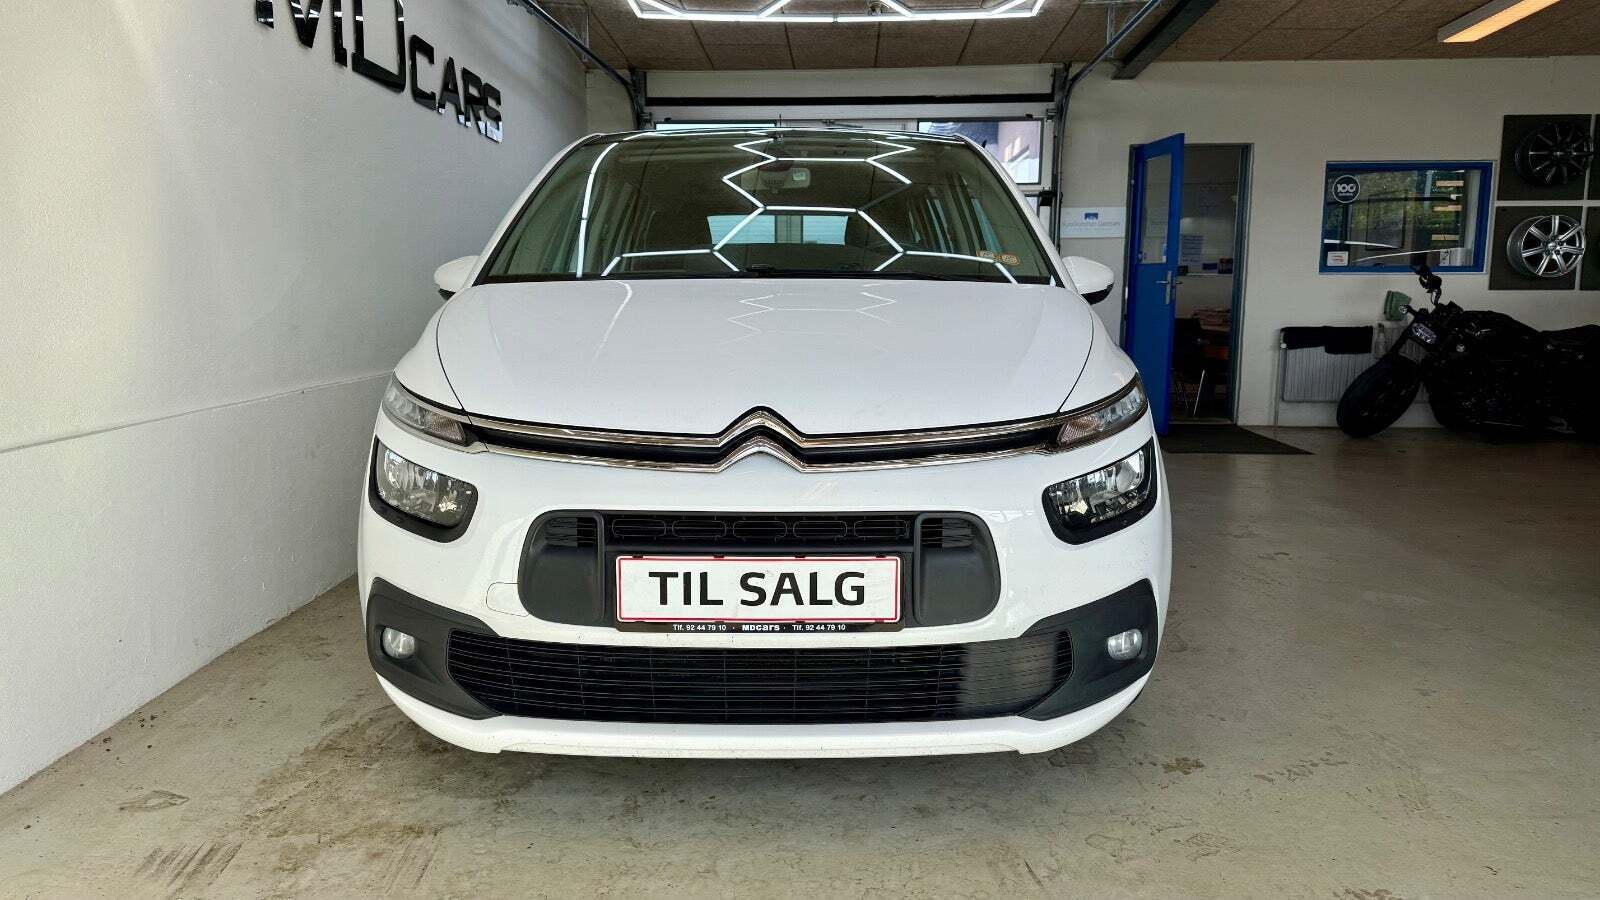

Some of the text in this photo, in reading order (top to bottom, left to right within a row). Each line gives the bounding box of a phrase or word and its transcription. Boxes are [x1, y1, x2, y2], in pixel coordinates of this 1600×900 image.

[1336, 183, 1356, 193] 100
[648, 571, 865, 607] TIL SALG
[741, 624, 781, 632] MDcars
